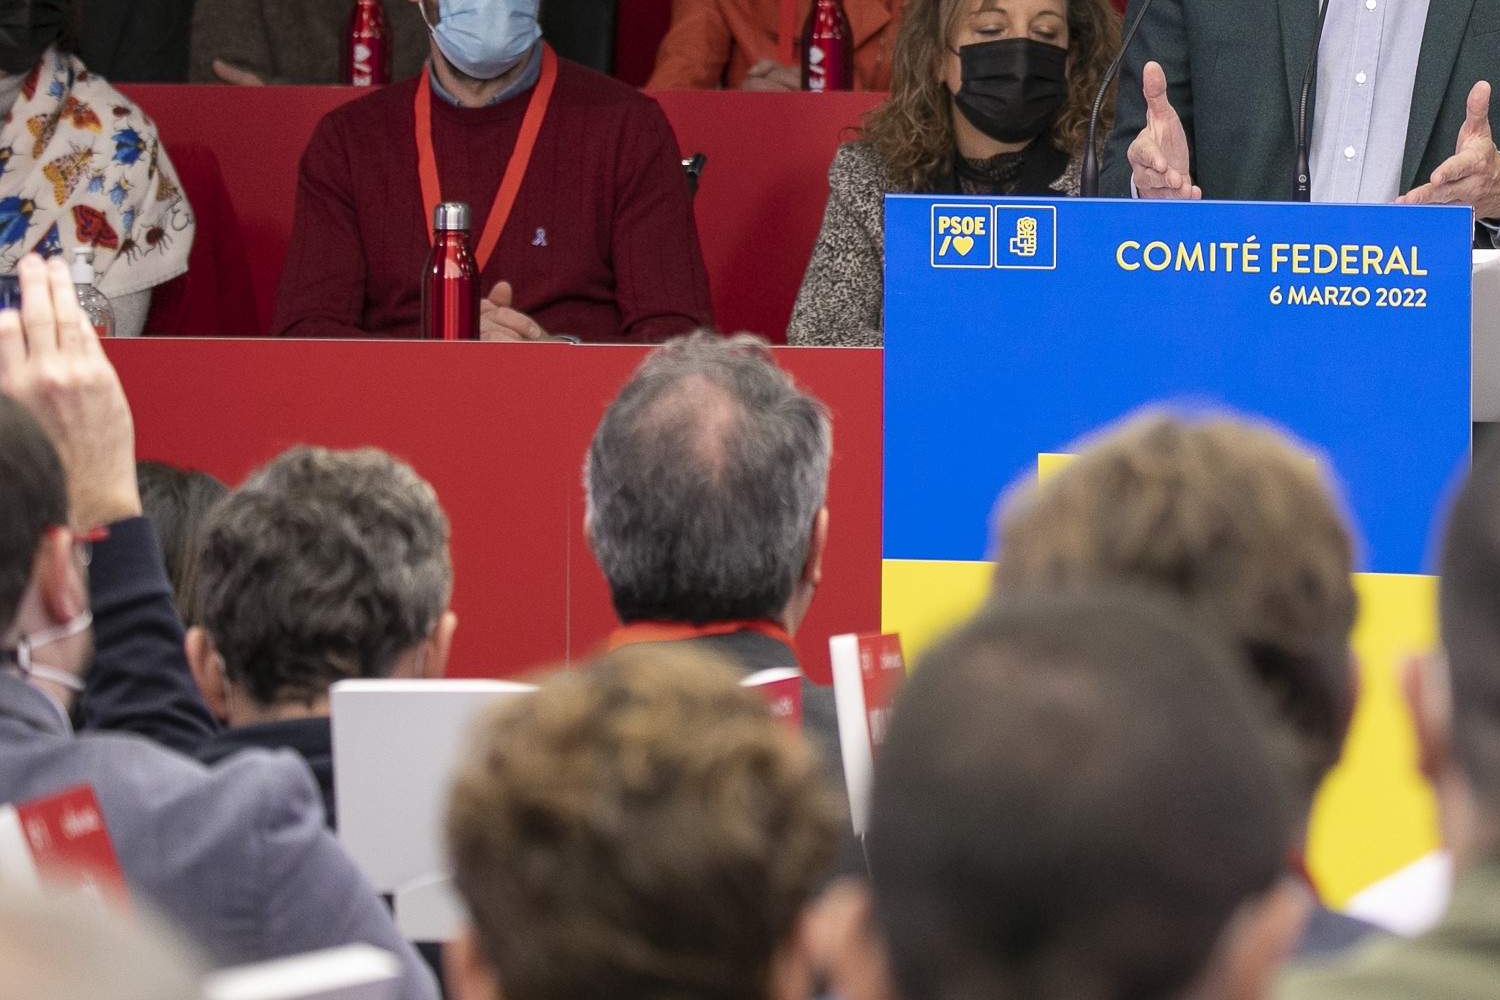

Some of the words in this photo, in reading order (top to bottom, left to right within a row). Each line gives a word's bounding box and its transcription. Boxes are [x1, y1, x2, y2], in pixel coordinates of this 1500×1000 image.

[938, 215, 986, 237] PSOE
[1115, 234, 1261, 273] COMITÉ
[1271, 243, 1428, 276] FEDERAL
[1269, 285, 1283, 305] 6
[1287, 285, 1371, 307] MARZO
[1375, 287, 1427, 308] 2022
